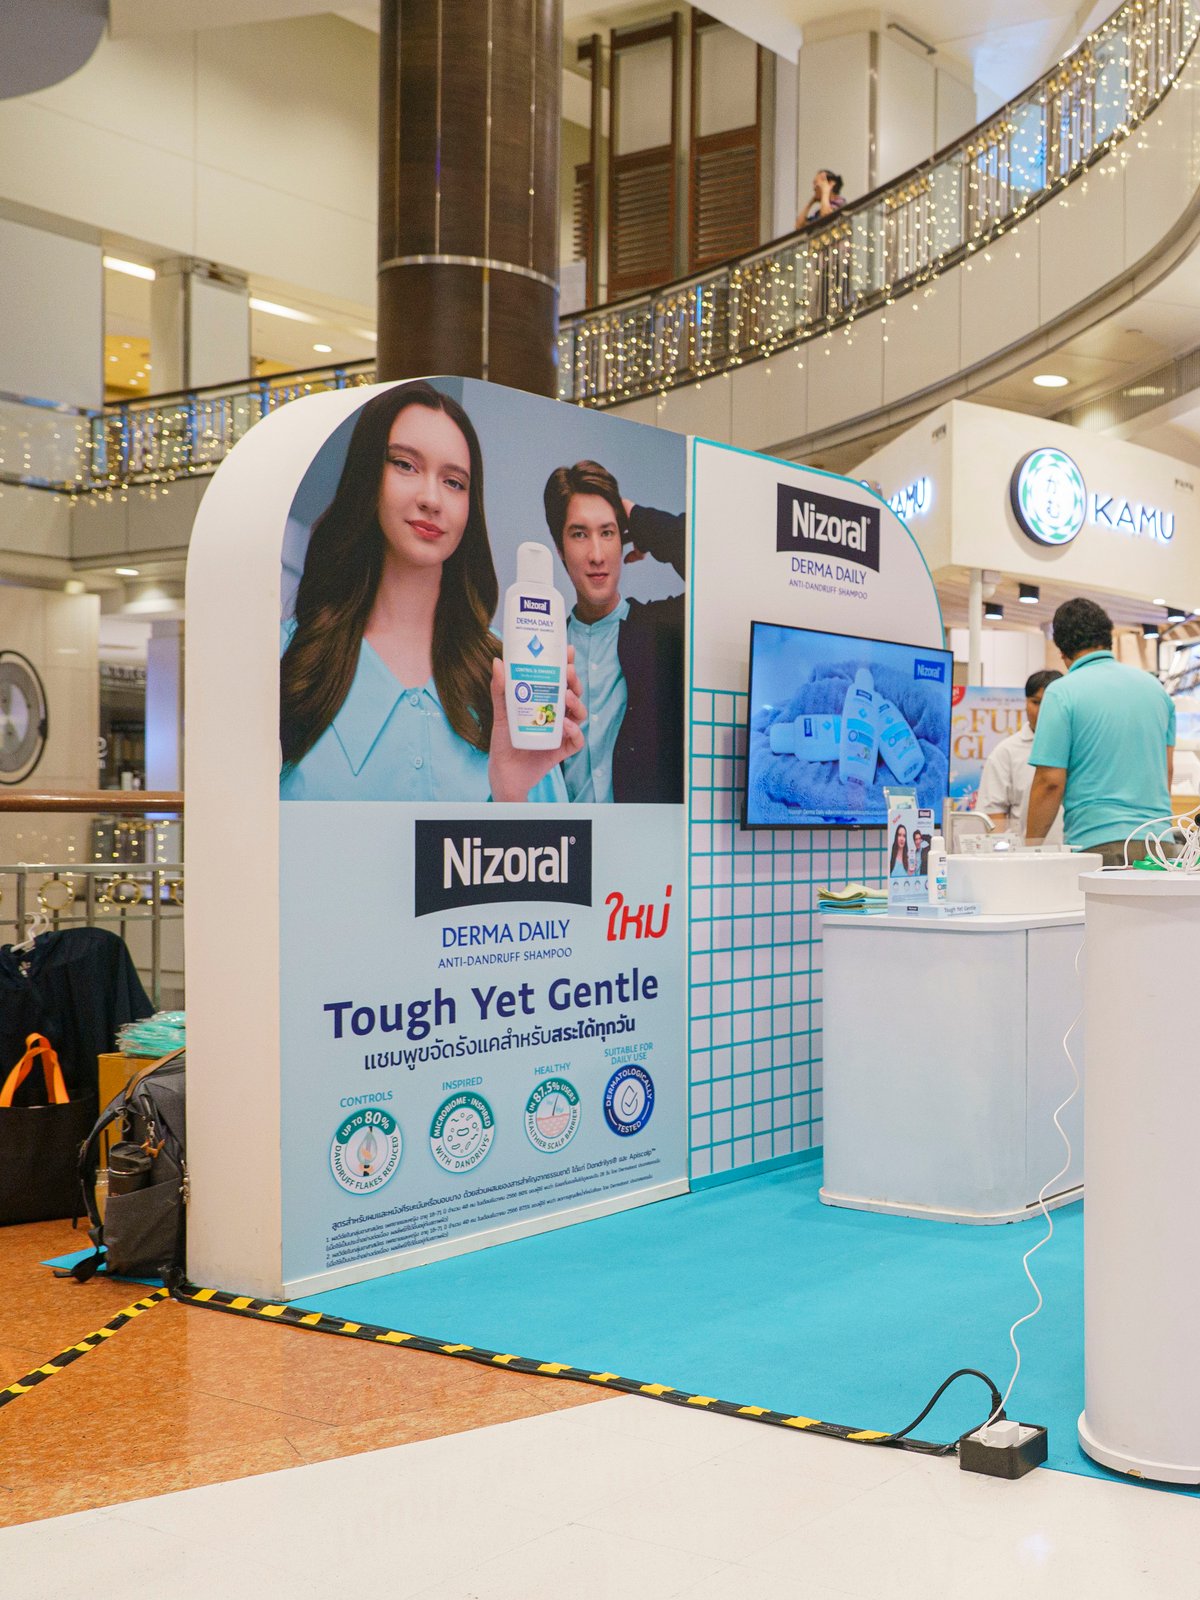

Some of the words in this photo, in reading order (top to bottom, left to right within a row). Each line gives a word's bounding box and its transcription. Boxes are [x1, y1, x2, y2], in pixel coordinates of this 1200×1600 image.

[1093, 493, 1175, 540] KAMU
[791, 556, 833, 580] DERMA
[836, 565, 867, 586] DAILY
[788, 578, 838, 595] ANTI-DANDRUFF
[838, 588, 868, 600] SHAMPOO
[516, 617, 538, 626] DERMA
[538, 619, 554, 627] DAILY
[917, 664, 942, 679] Nizoral
[604, 884, 673, 942] ใหม่
[442, 923, 514, 948] DERMA
[519, 919, 571, 942] DAILY
[438, 951, 521, 969] ANTI-DANDRUFF
[524, 947, 573, 961] SHAMPOO
[323, 987, 457, 1041] Tough
[471, 982, 536, 1021] Yet
[548, 967, 659, 1011] Gentle
[604, 1044, 638, 1058] SUITABLE
[639, 1042, 654, 1051] FOR
[611, 1055, 633, 1065] DAILY
[633, 1052, 648, 1061] USE
[534, 1062, 571, 1076] HEALTHY
[442, 1076, 483, 1091] INSPIRED
[605, 1067, 653, 1108] DERMATOLOGICALLY
[340, 1090, 393, 1108] CONTROLS
[528, 1102, 536, 1112] IN
[533, 1080, 561, 1102] 87.5%
[561, 1084, 577, 1103] USERS
[341, 1124, 352, 1137] UP
[351, 1116, 363, 1127] TO
[364, 1110, 391, 1131] 80%
[527, 1114, 547, 1149] HEALTHIER
[547, 1136, 565, 1150] SCALP
[617, 1120, 642, 1133] TESTED
[435, 1144, 453, 1166] WITH
[334, 1145, 355, 1187] DANDRUFF
[355, 1176, 384, 1190] FLAKES
